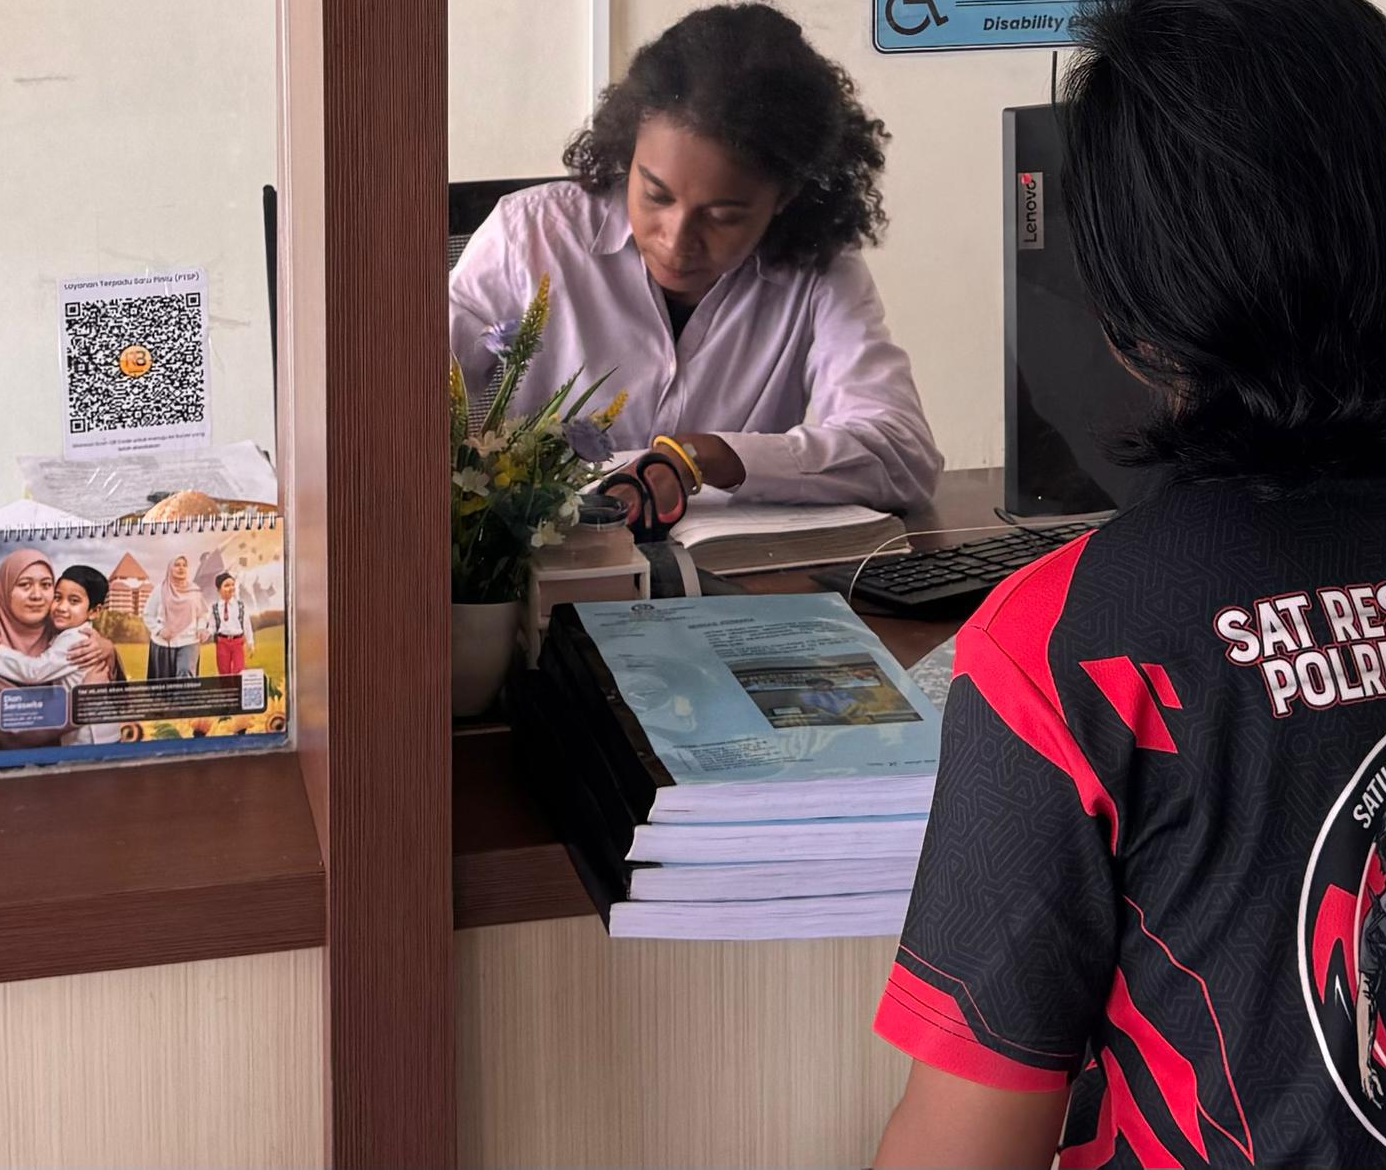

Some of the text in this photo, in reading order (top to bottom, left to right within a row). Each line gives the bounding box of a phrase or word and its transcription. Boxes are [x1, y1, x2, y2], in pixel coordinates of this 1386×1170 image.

[983, 14, 1064, 33] Disability
[1023, 177, 1038, 243] Lenovo
[1216, 593, 1315, 663] SAT
